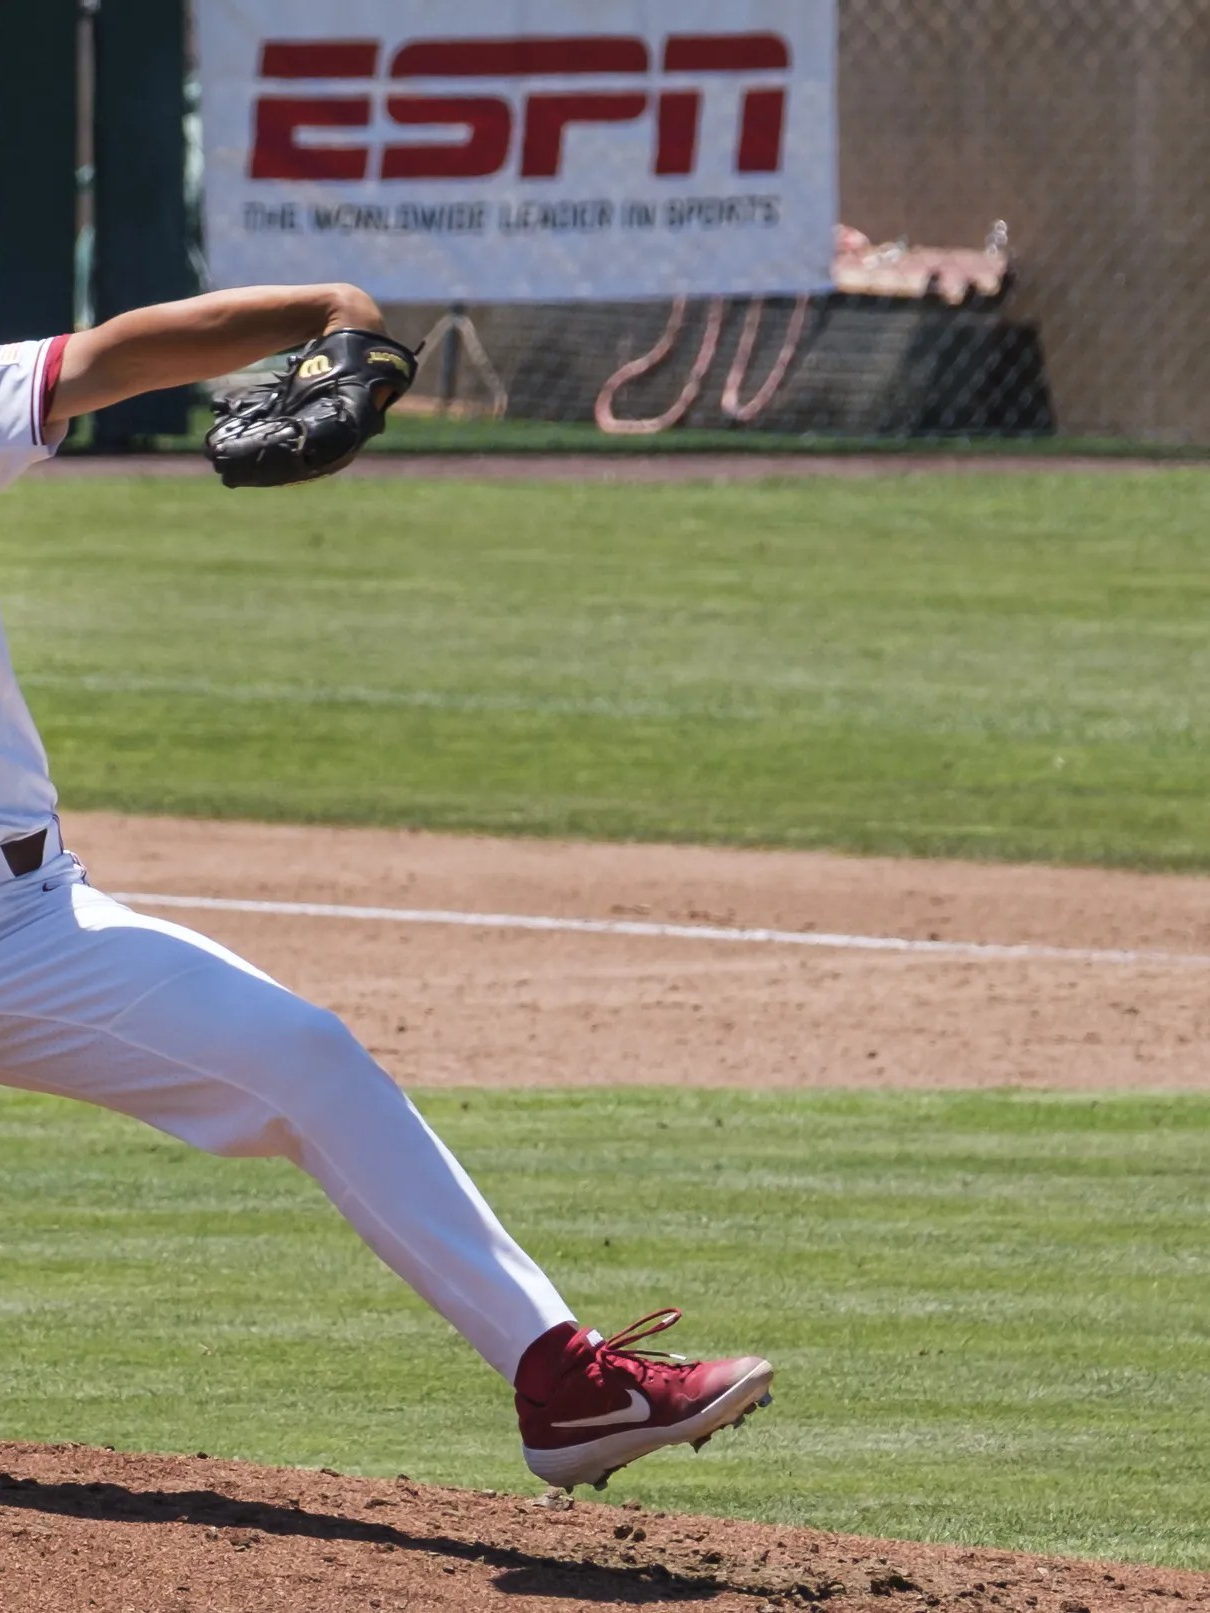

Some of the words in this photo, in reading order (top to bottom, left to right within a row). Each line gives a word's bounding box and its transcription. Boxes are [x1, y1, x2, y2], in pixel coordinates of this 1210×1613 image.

[247, 32, 791, 181] ESPN
[243, 202, 296, 233] THE
[313, 201, 485, 236] WORLDWIDE
[498, 199, 613, 236] LEADER
[621, 199, 657, 231] IN
[666, 195, 779, 231] SPORTS
